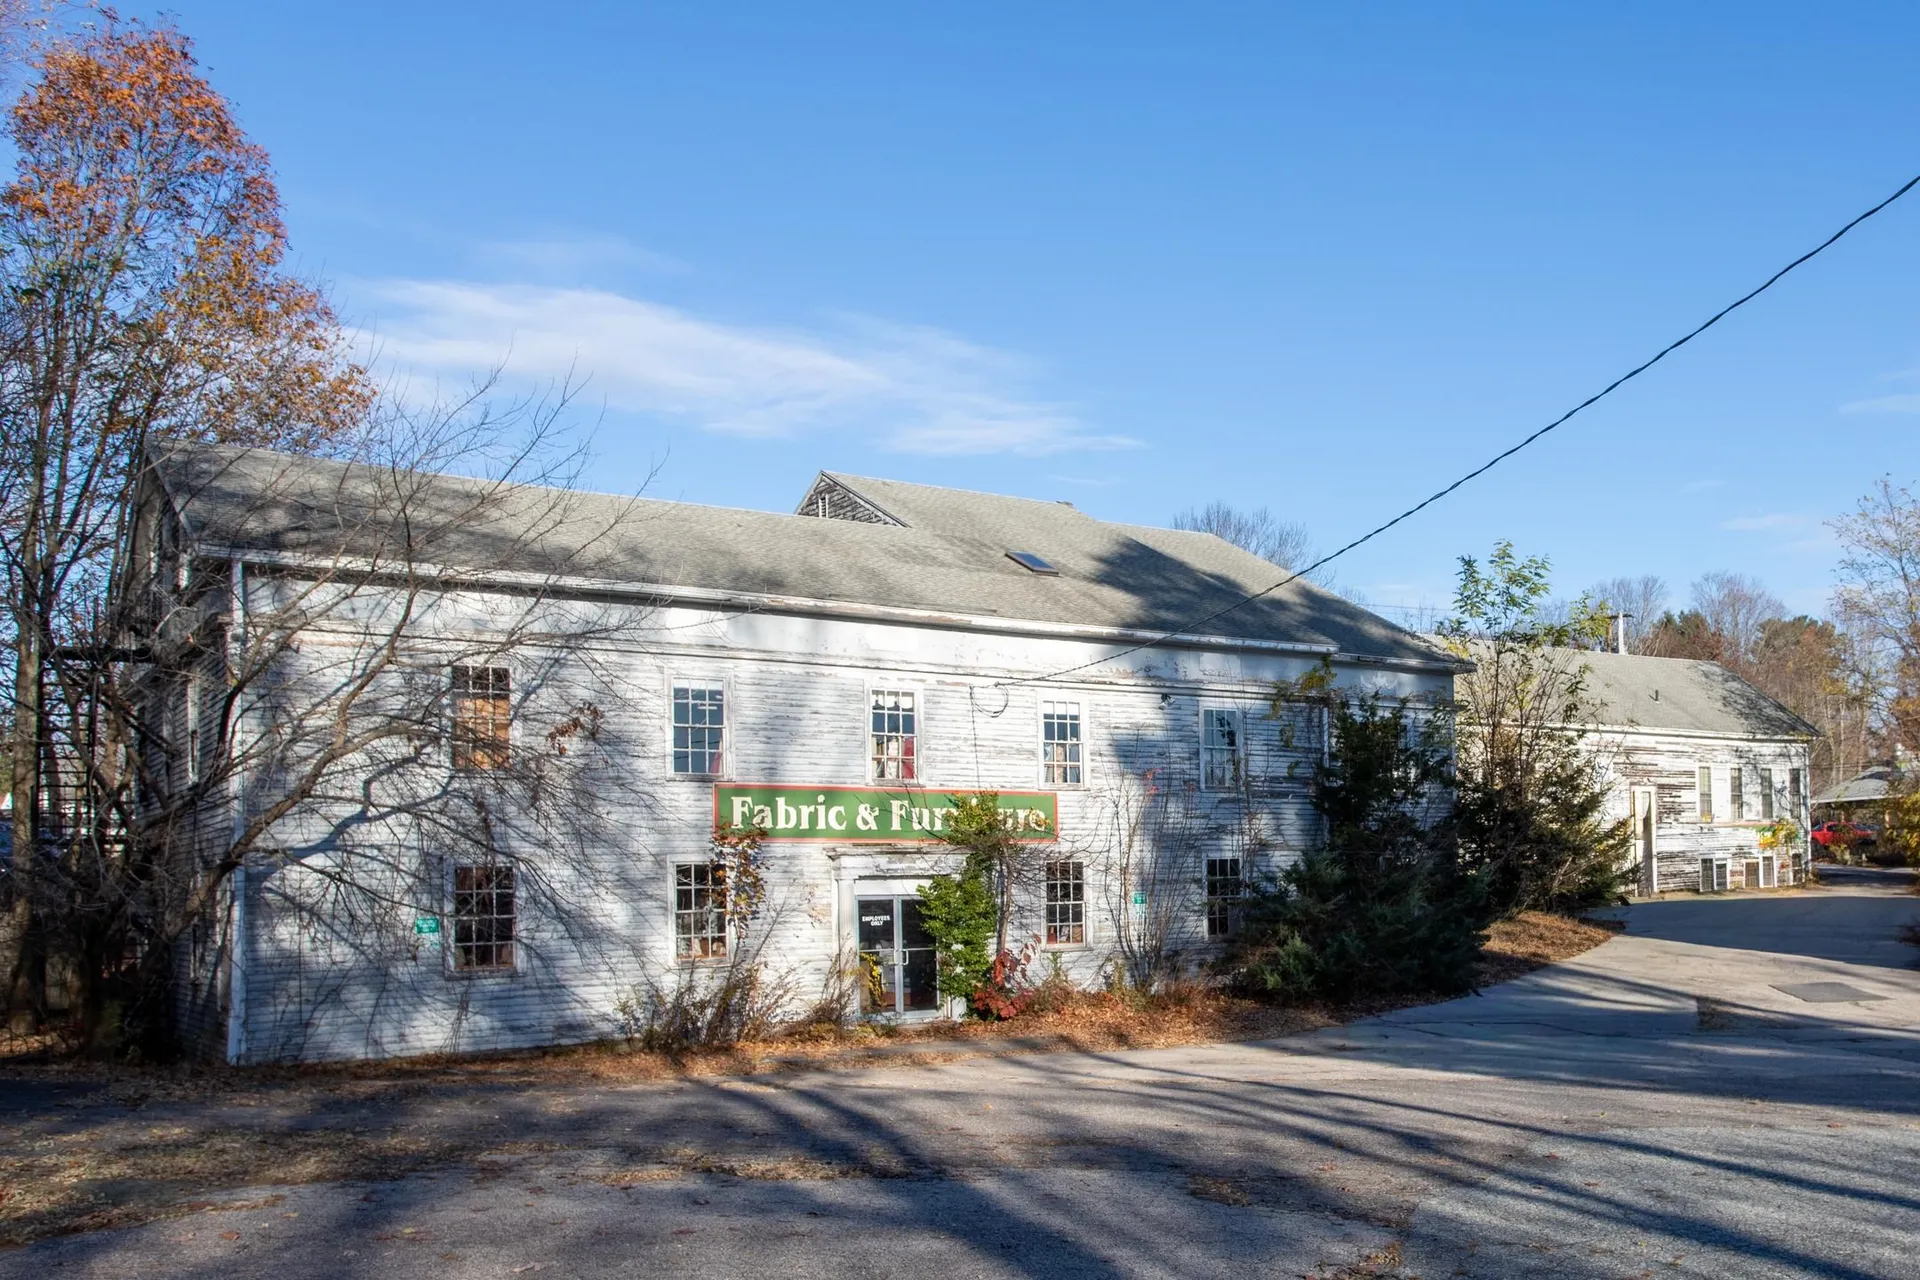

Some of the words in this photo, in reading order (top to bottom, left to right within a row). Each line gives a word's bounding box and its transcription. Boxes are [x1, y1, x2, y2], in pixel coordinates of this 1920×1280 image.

[730, 795, 847, 830] Fabric
[856, 802, 880, 831] &
[889, 797, 1046, 832] Furure
